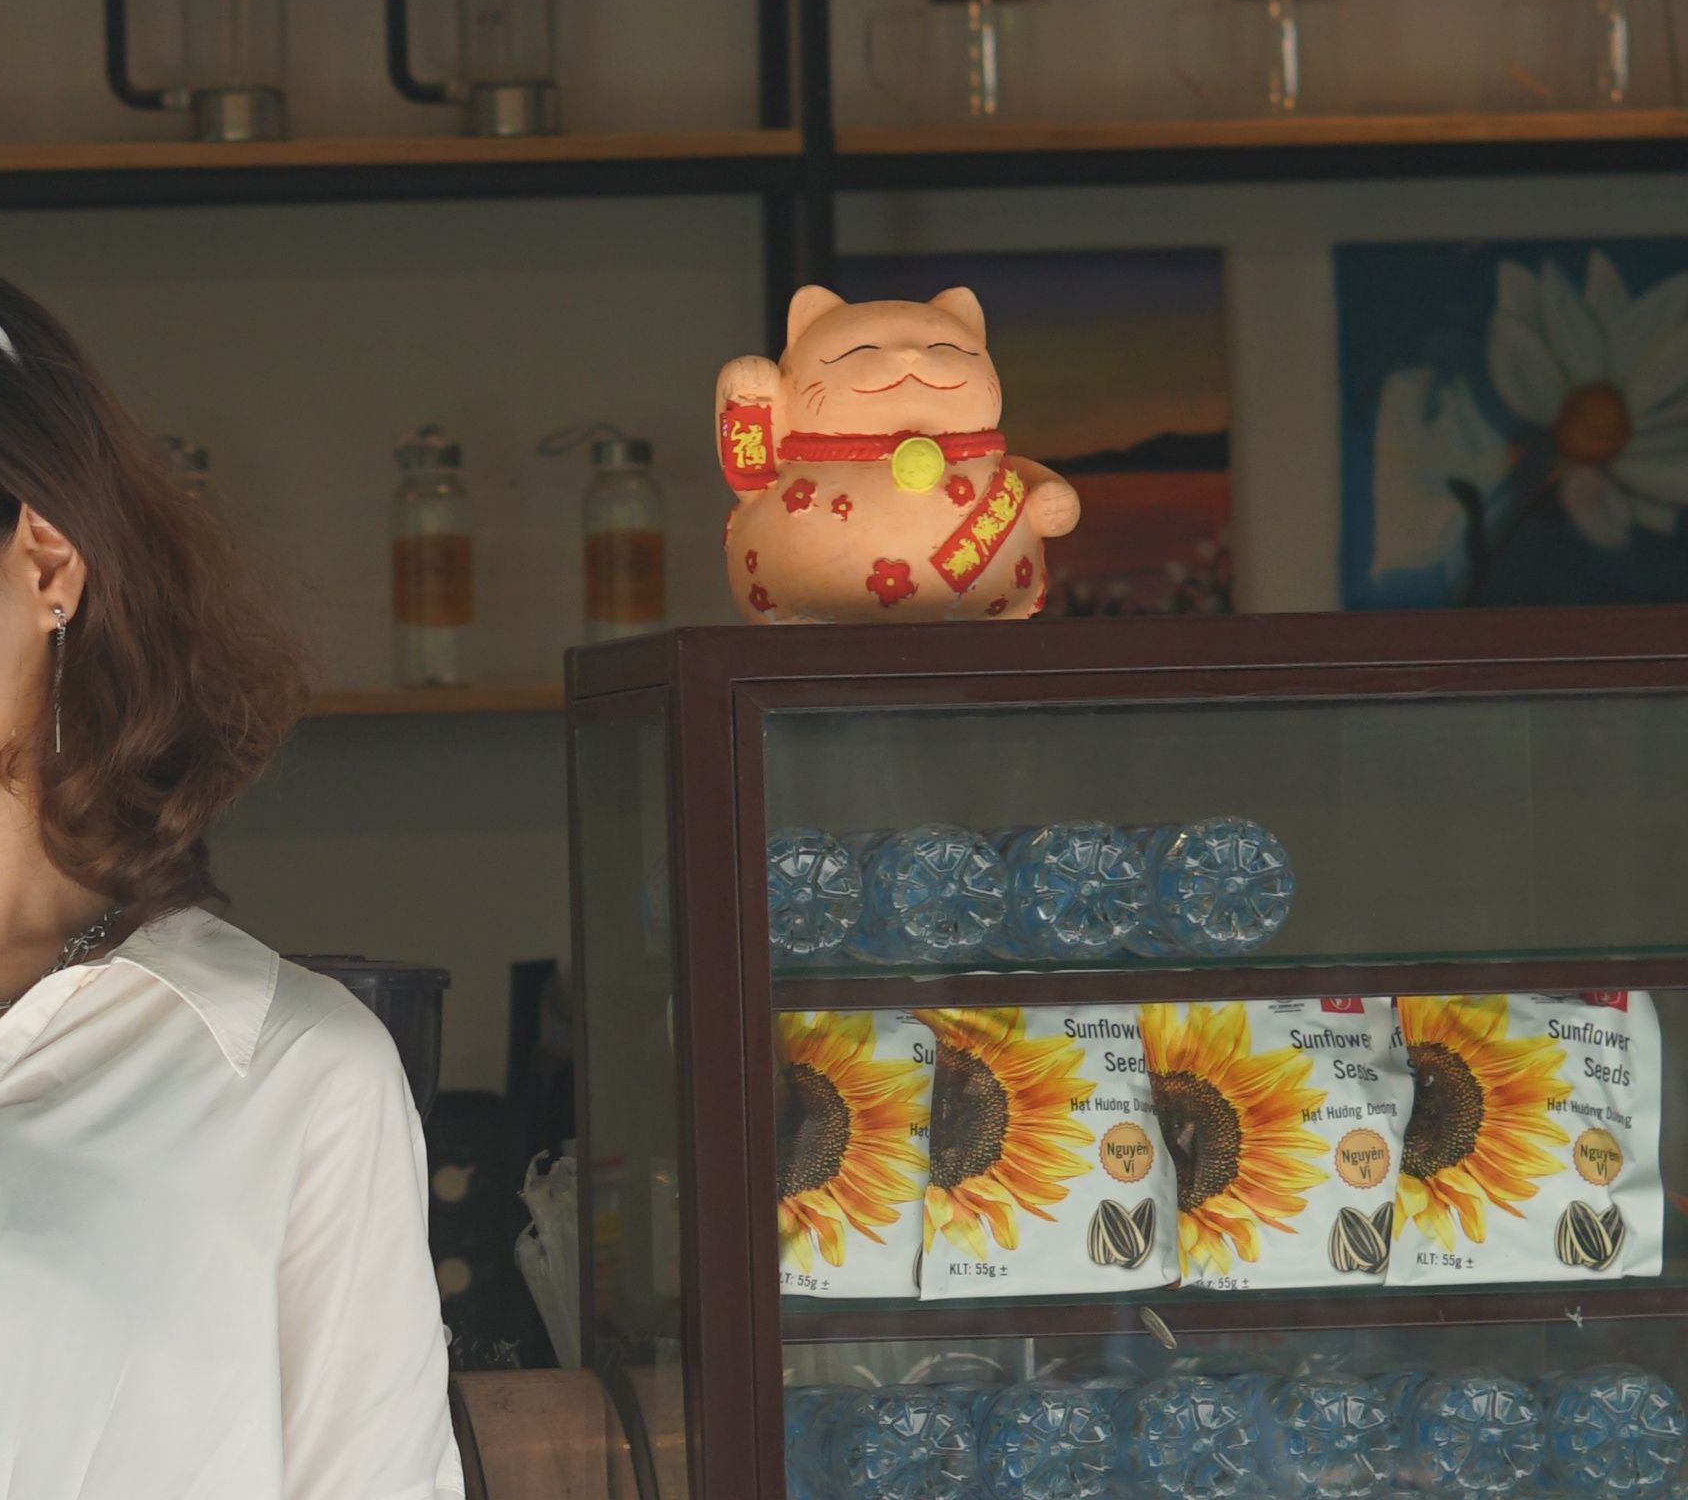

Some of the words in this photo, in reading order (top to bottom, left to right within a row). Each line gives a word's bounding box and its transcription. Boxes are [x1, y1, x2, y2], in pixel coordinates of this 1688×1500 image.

[1548, 1019, 1631, 1051] Sunflower
[1584, 1057, 1631, 1087] Seeds
[1416, 1251, 1439, 1266] KLT:
[1441, 1254, 1463, 1269] 55g
[949, 1262, 972, 1275] KLT:
[975, 1263, 996, 1277] 55g
[797, 1274, 818, 1291] 55g
